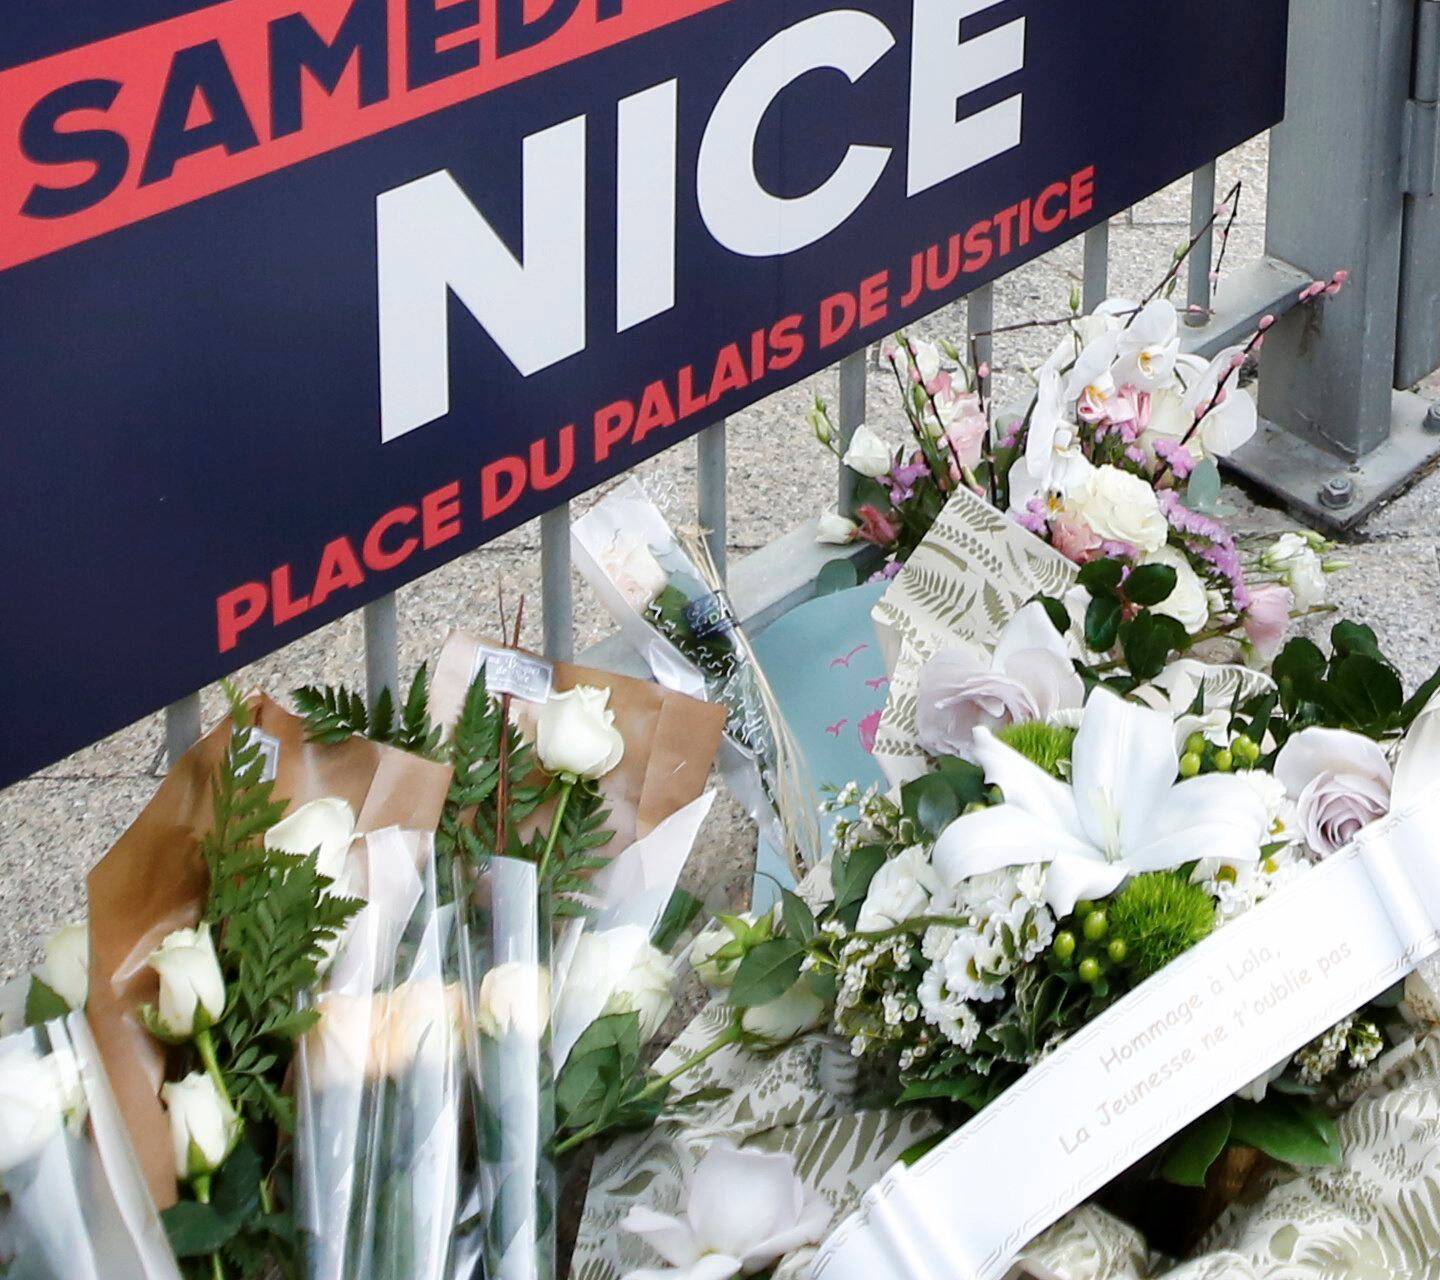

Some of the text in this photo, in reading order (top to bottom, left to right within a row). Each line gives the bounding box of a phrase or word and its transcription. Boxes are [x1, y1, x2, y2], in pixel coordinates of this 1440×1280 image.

[214, 165, 1097, 655] PLACE DU PALAIS DE JUSTICE
[1058, 941, 1353, 1156] La Jeunesse ne t'oublie pas
[1098, 991, 1204, 1074] Hommage
[1227, 944, 1282, 984] Lola,
